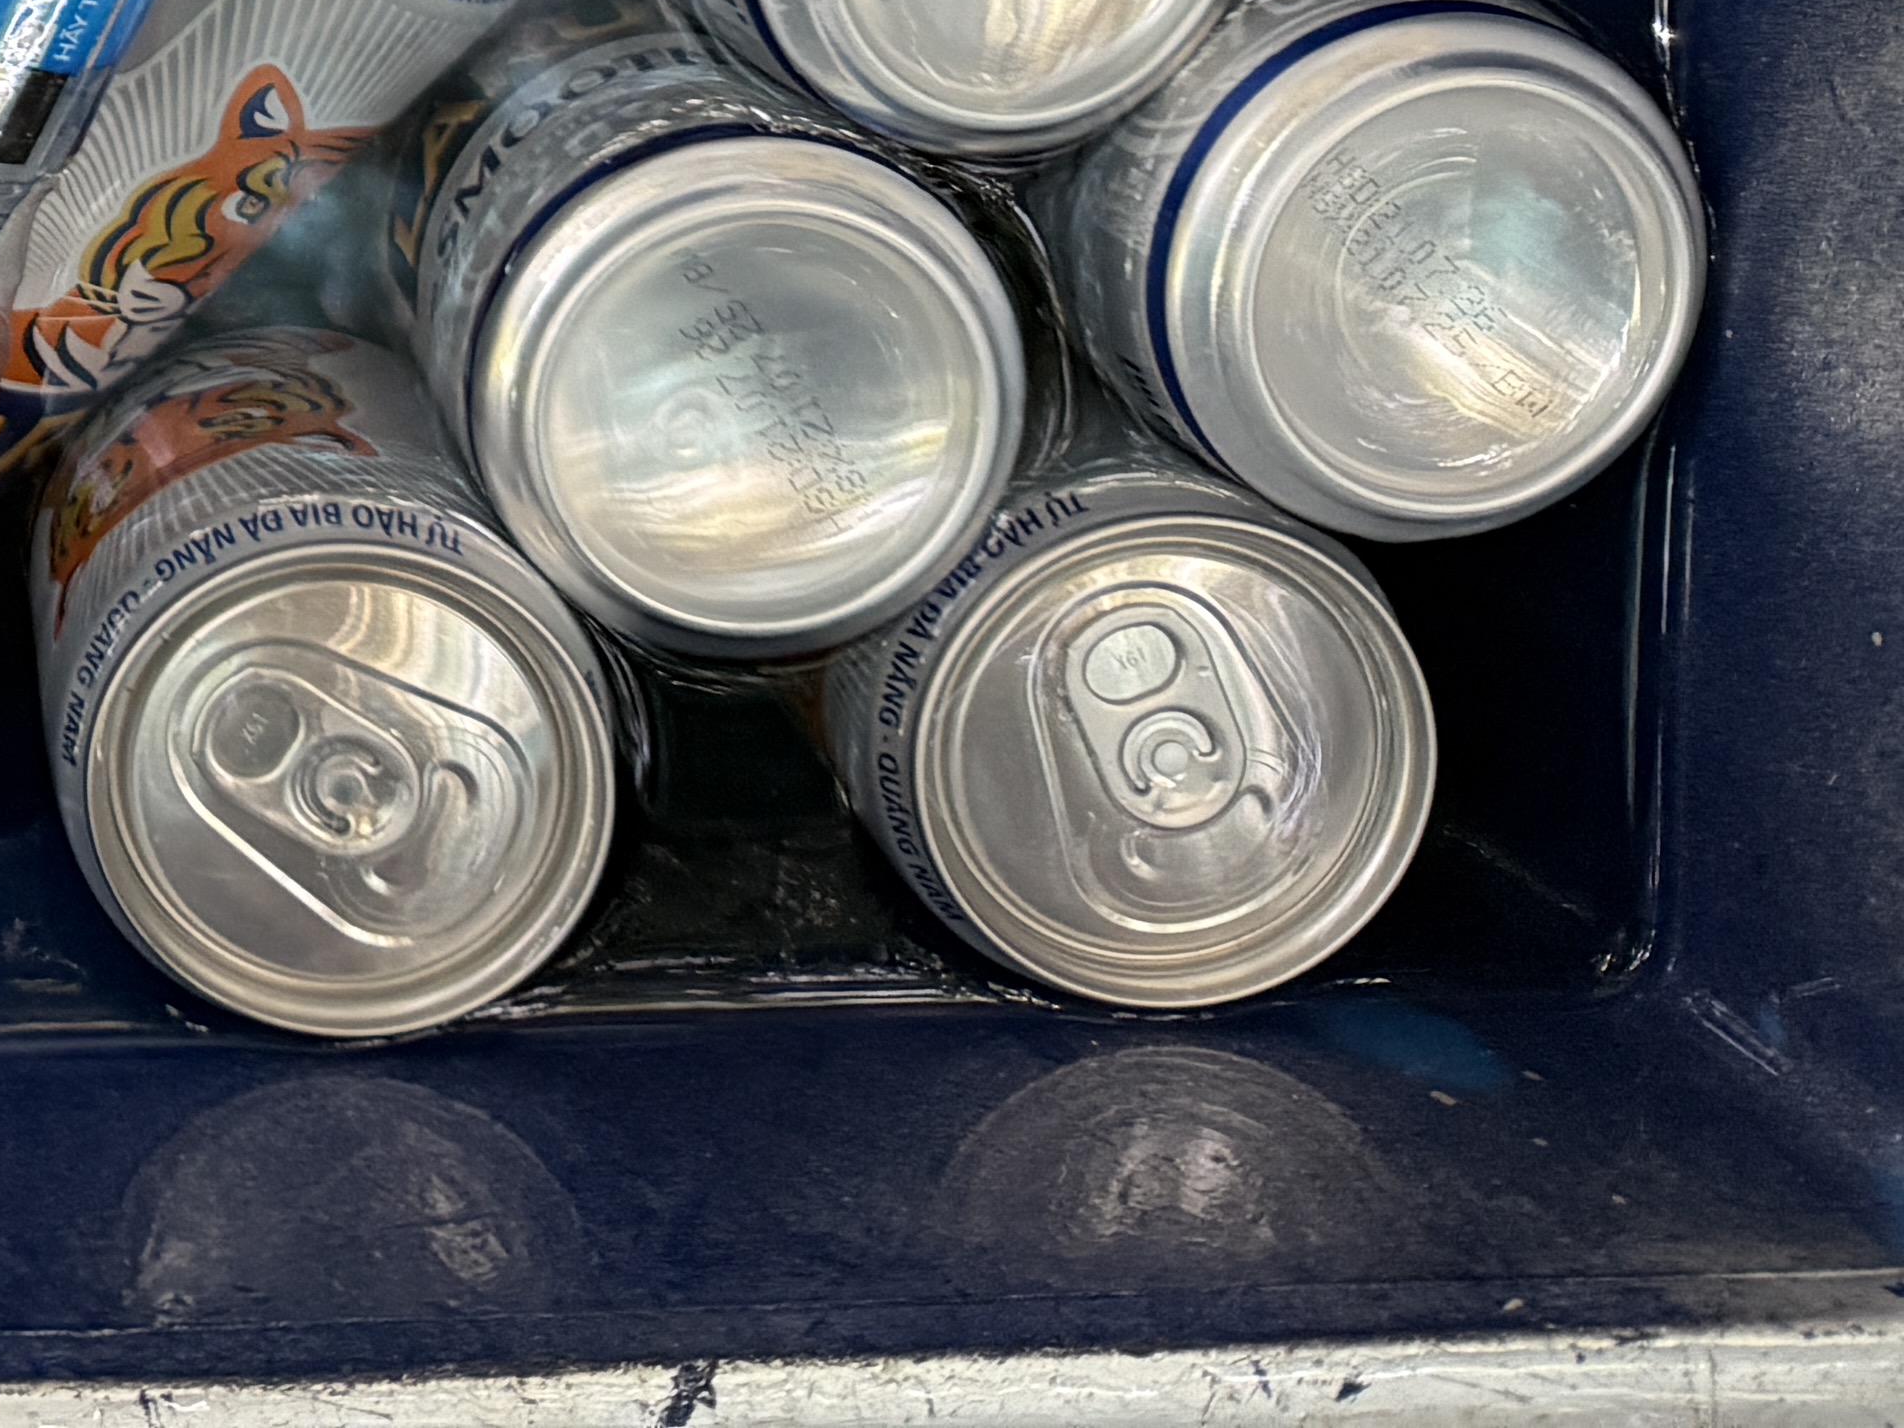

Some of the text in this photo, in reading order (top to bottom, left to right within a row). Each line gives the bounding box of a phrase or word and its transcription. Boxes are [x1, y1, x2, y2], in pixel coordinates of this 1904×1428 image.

[50, 10, 89, 63] HÃY
[237, 509, 284, 542] ĐÀ
[287, 502, 342, 529] BIA
[351, 503, 420, 536] HÀO
[1044, 490, 1091, 527] TỰ
[155, 523, 237, 583] NẴNG
[425, 514, 463, 556] TỰ
[879, 641, 922, 731] NẴNG
[877, 751, 920, 857] QUẢNG
[907, 861, 964, 922] NAM
